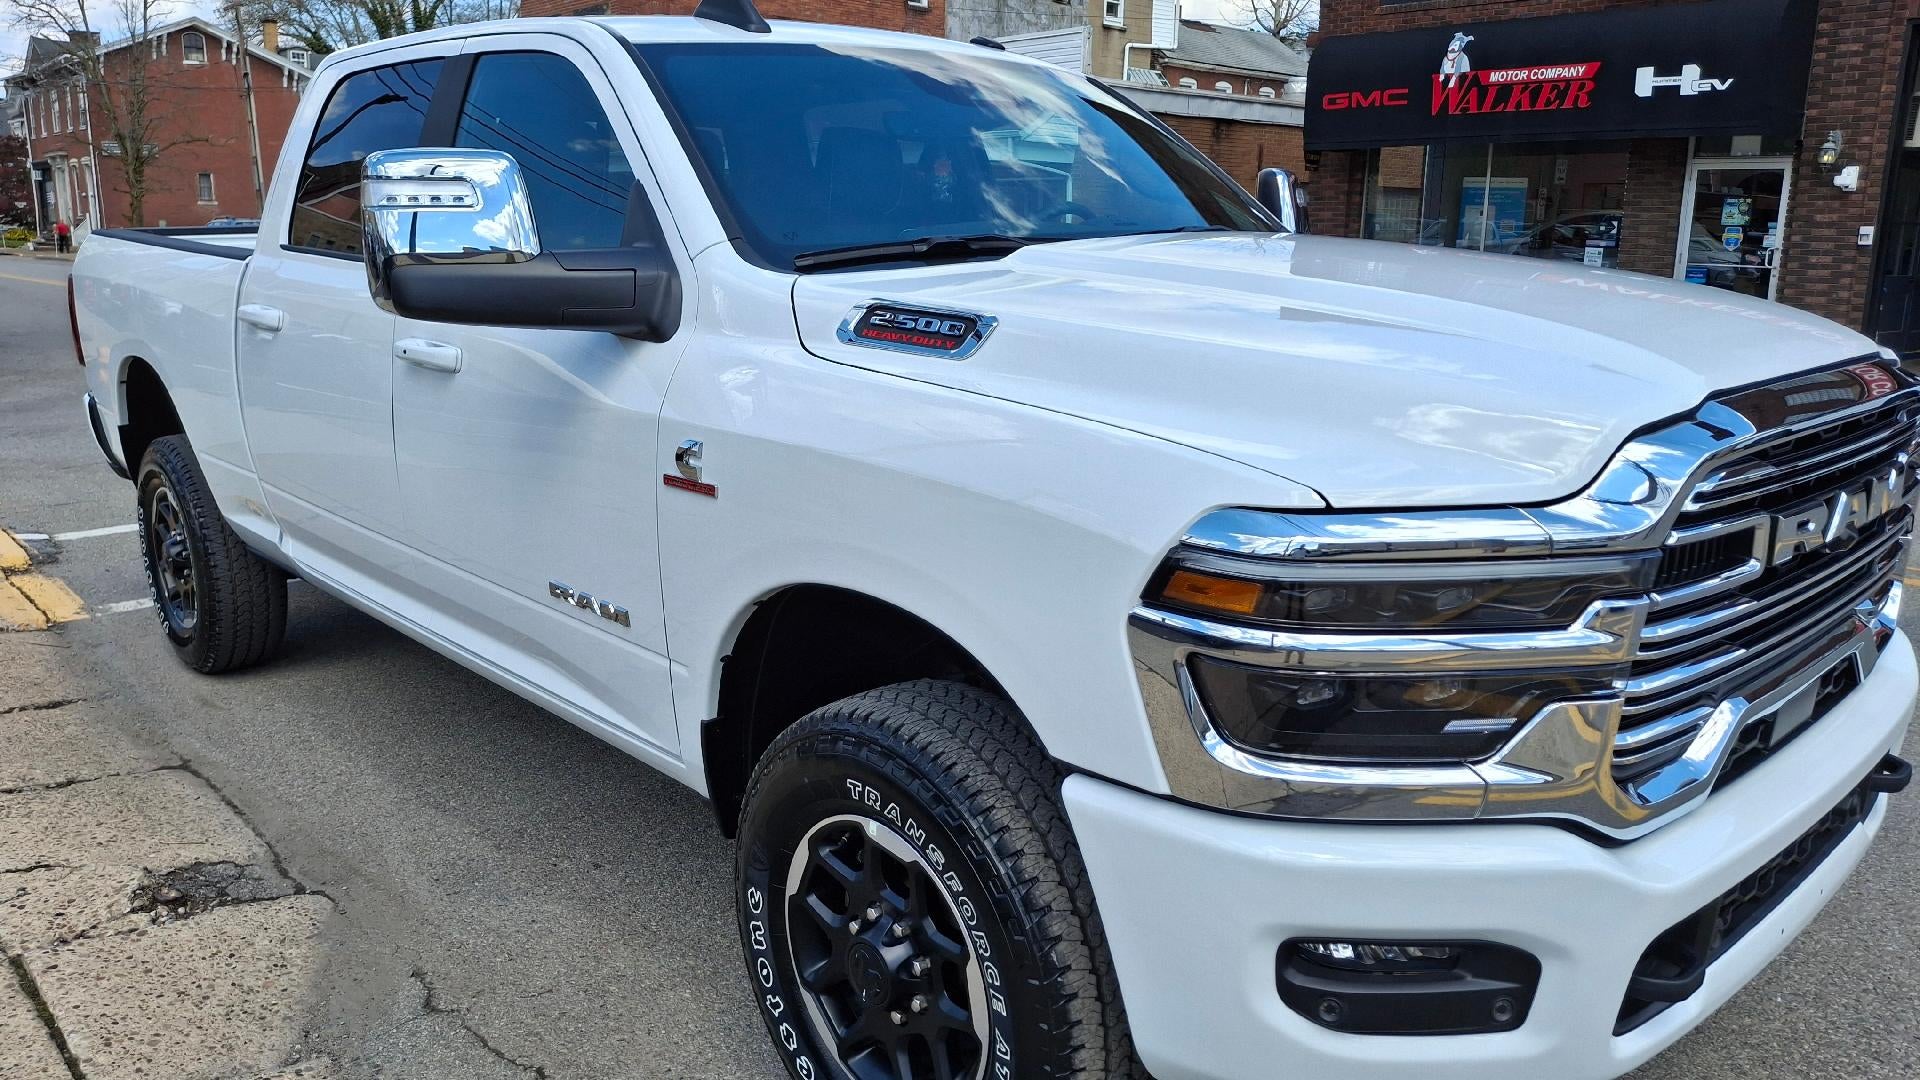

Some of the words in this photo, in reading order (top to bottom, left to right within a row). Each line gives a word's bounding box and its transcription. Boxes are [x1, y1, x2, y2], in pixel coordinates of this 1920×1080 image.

[1489, 69, 1528, 83] MOTOR
[1530, 65, 1586, 80] COMPANY
[1322, 88, 1409, 110] GMC
[1431, 72, 1596, 118] WALKER
[862, 329, 911, 343] HEAVY
[911, 336, 957, 349] DUTY
[869, 310, 966, 337] 2500
[1771, 461, 1906, 566] RAM
[548, 579, 631, 628] RAM
[847, 779, 1007, 1017] TRANSFORCE
